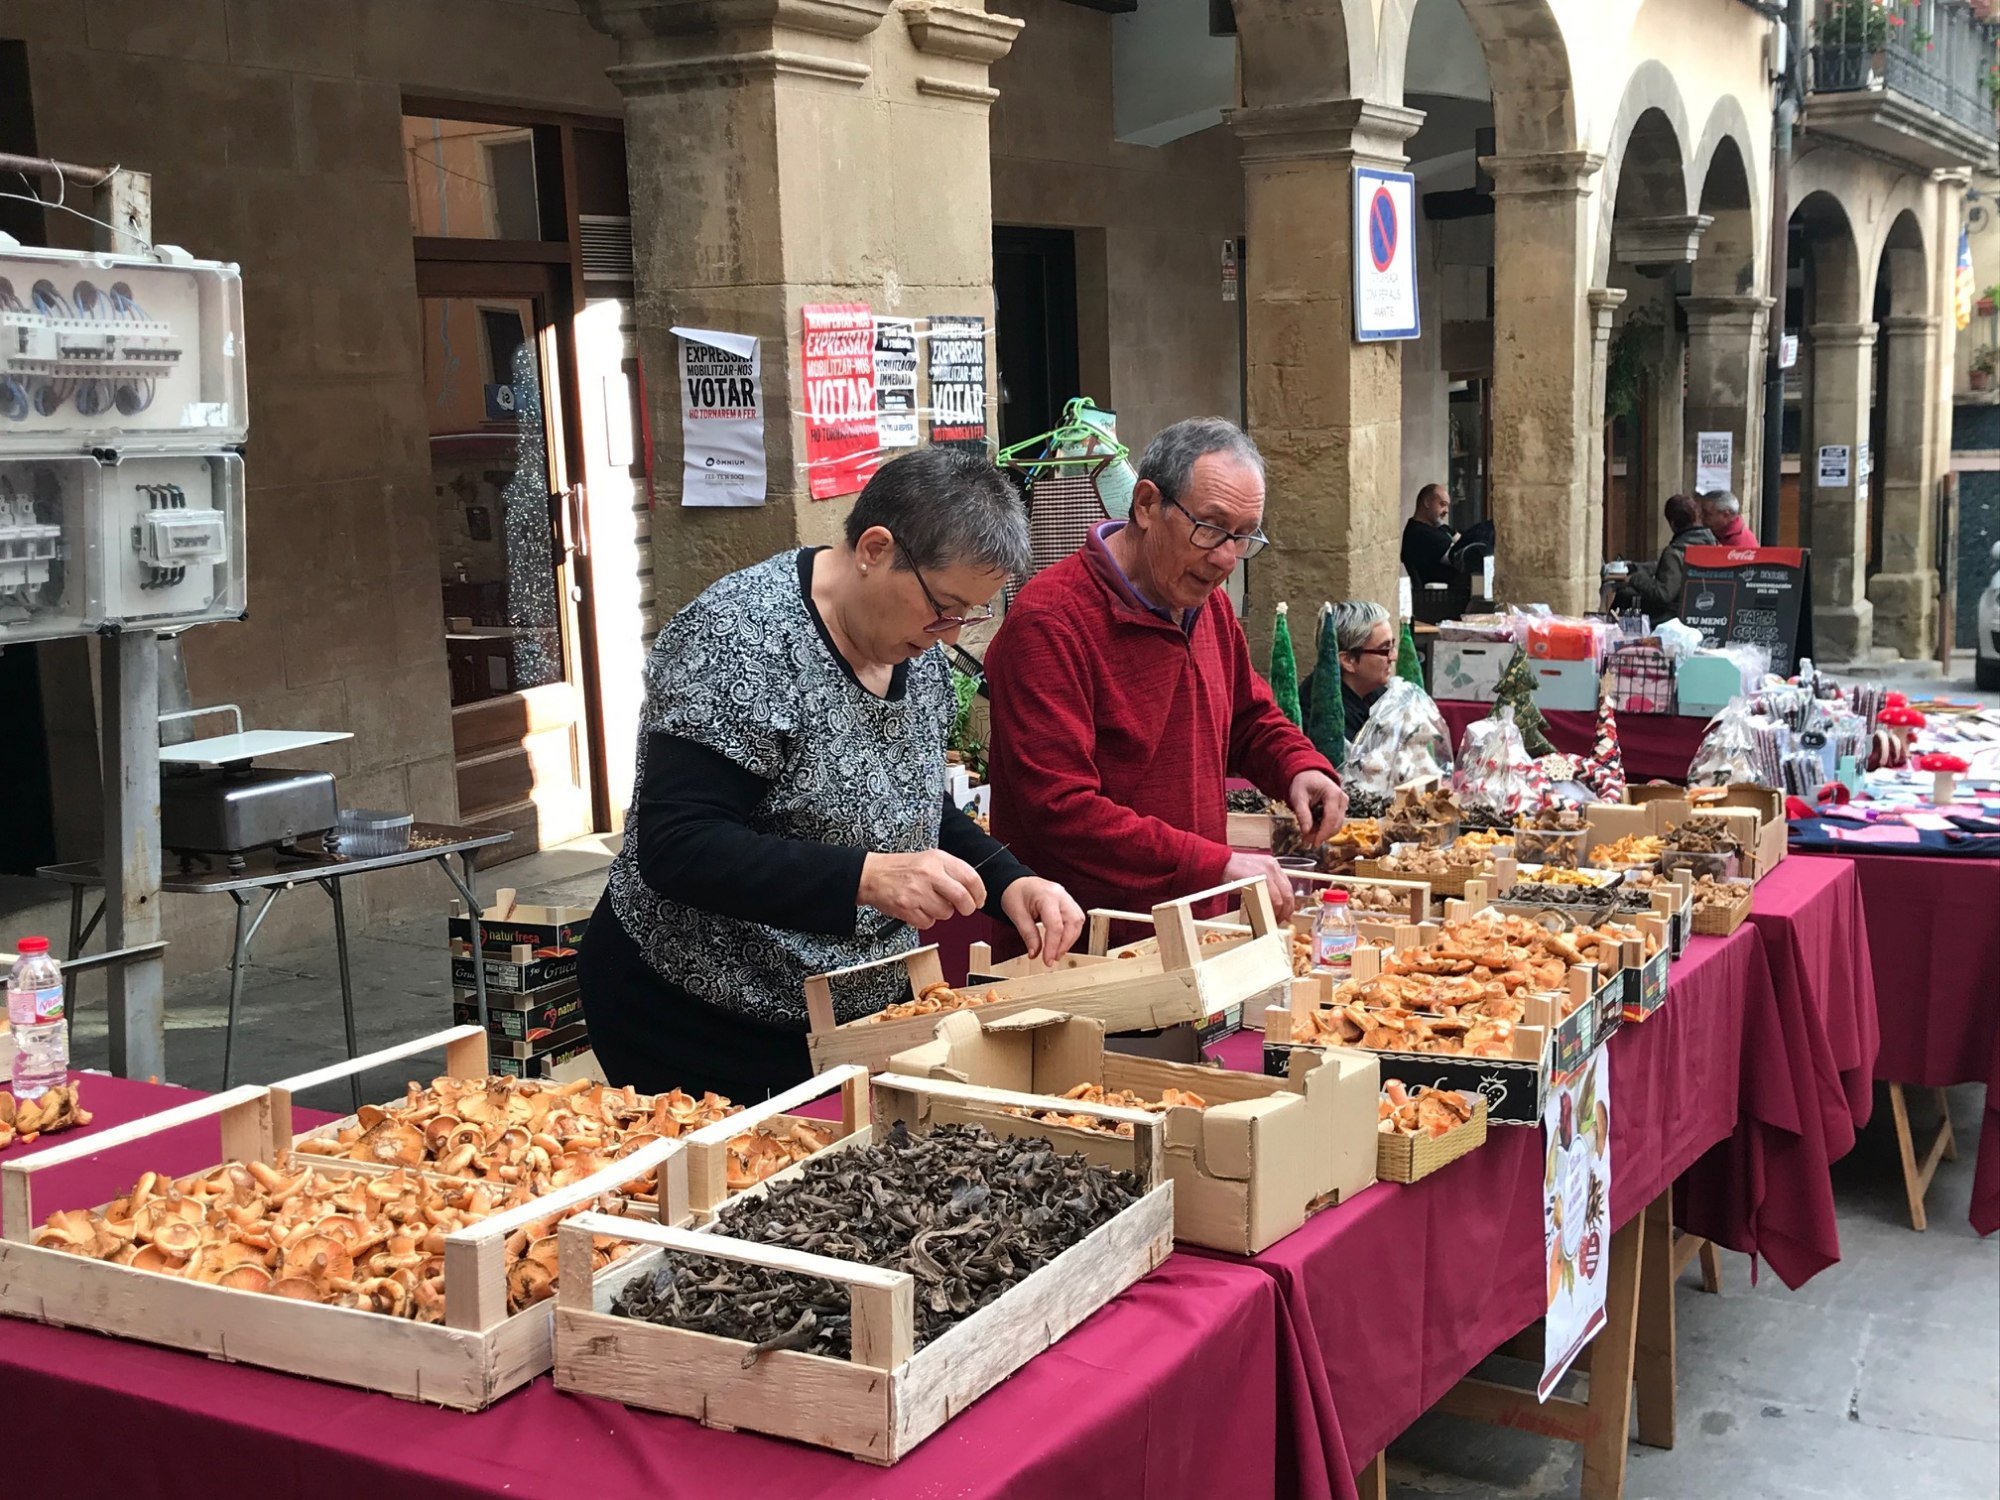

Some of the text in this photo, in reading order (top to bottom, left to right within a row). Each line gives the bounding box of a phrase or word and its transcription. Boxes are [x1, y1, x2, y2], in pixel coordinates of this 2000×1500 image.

[806, 331, 869, 357] EXPRESSAR
[931, 340, 983, 364] EXPRESSAR
[686, 346, 753, 363] EXPRESS
[687, 364, 753, 376] MOBILITZAR-NOS
[806, 358, 871, 378] MOBILITZAR-NOS
[687, 378, 756, 408] VOTAR
[807, 377, 872, 425] VOTAR
[932, 383, 984, 425] VOTAR
[689, 409, 699, 419] HO
[700, 409, 736, 419] TORNAREM
[743, 409, 757, 419] FER
[1701, 453, 1728, 465] VOTAR
[1727, 549, 1757, 561] Coca-Cola
[1686, 615, 1728, 626] TU MENÚ
[1736, 609, 1777, 626] TAPES
